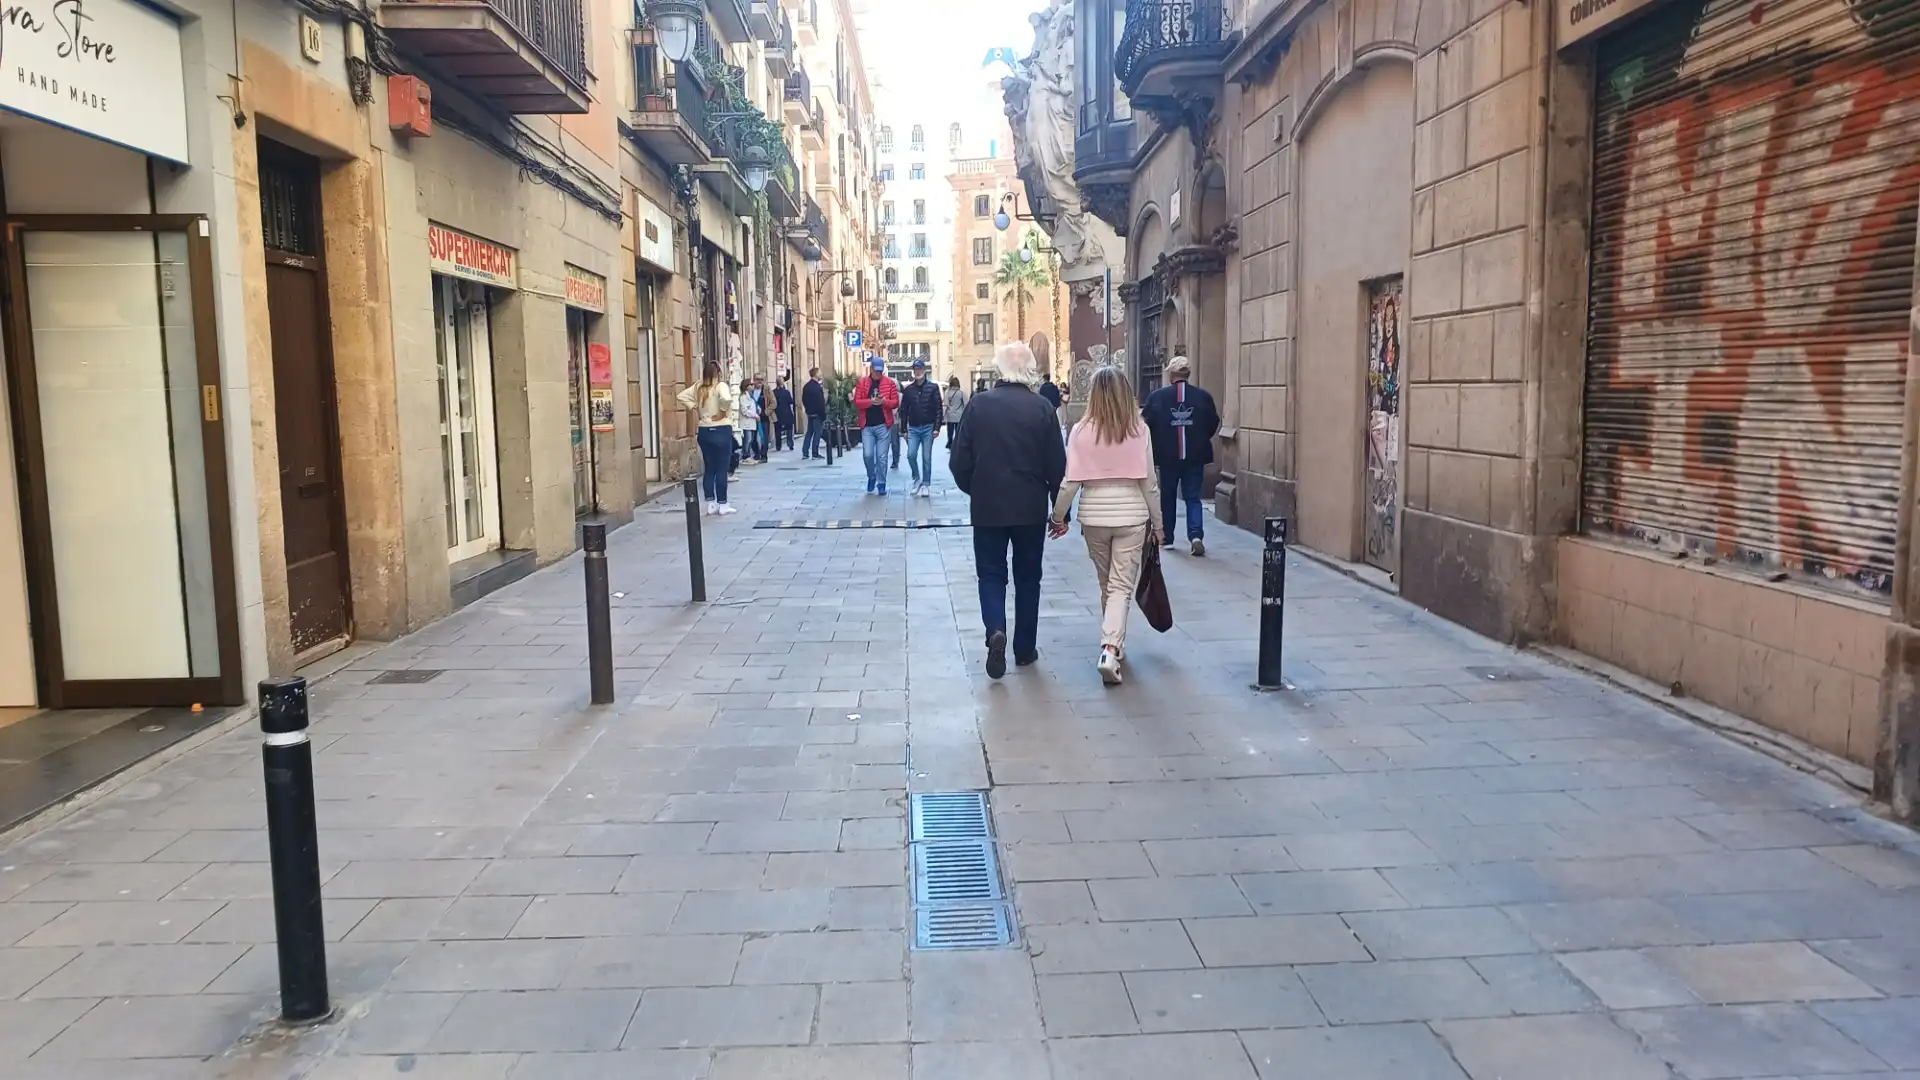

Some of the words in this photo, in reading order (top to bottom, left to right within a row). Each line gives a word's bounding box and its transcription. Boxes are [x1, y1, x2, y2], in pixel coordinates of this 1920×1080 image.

[53, 0, 116, 62] Store
[308, 25, 320, 52] 16
[17, 66, 58, 94] HAND
[70, 85, 107, 112] MADE
[428, 226, 512, 278] SUPERMERCAT
[848, 332, 859, 345] P
[863, 351, 872, 362] P
